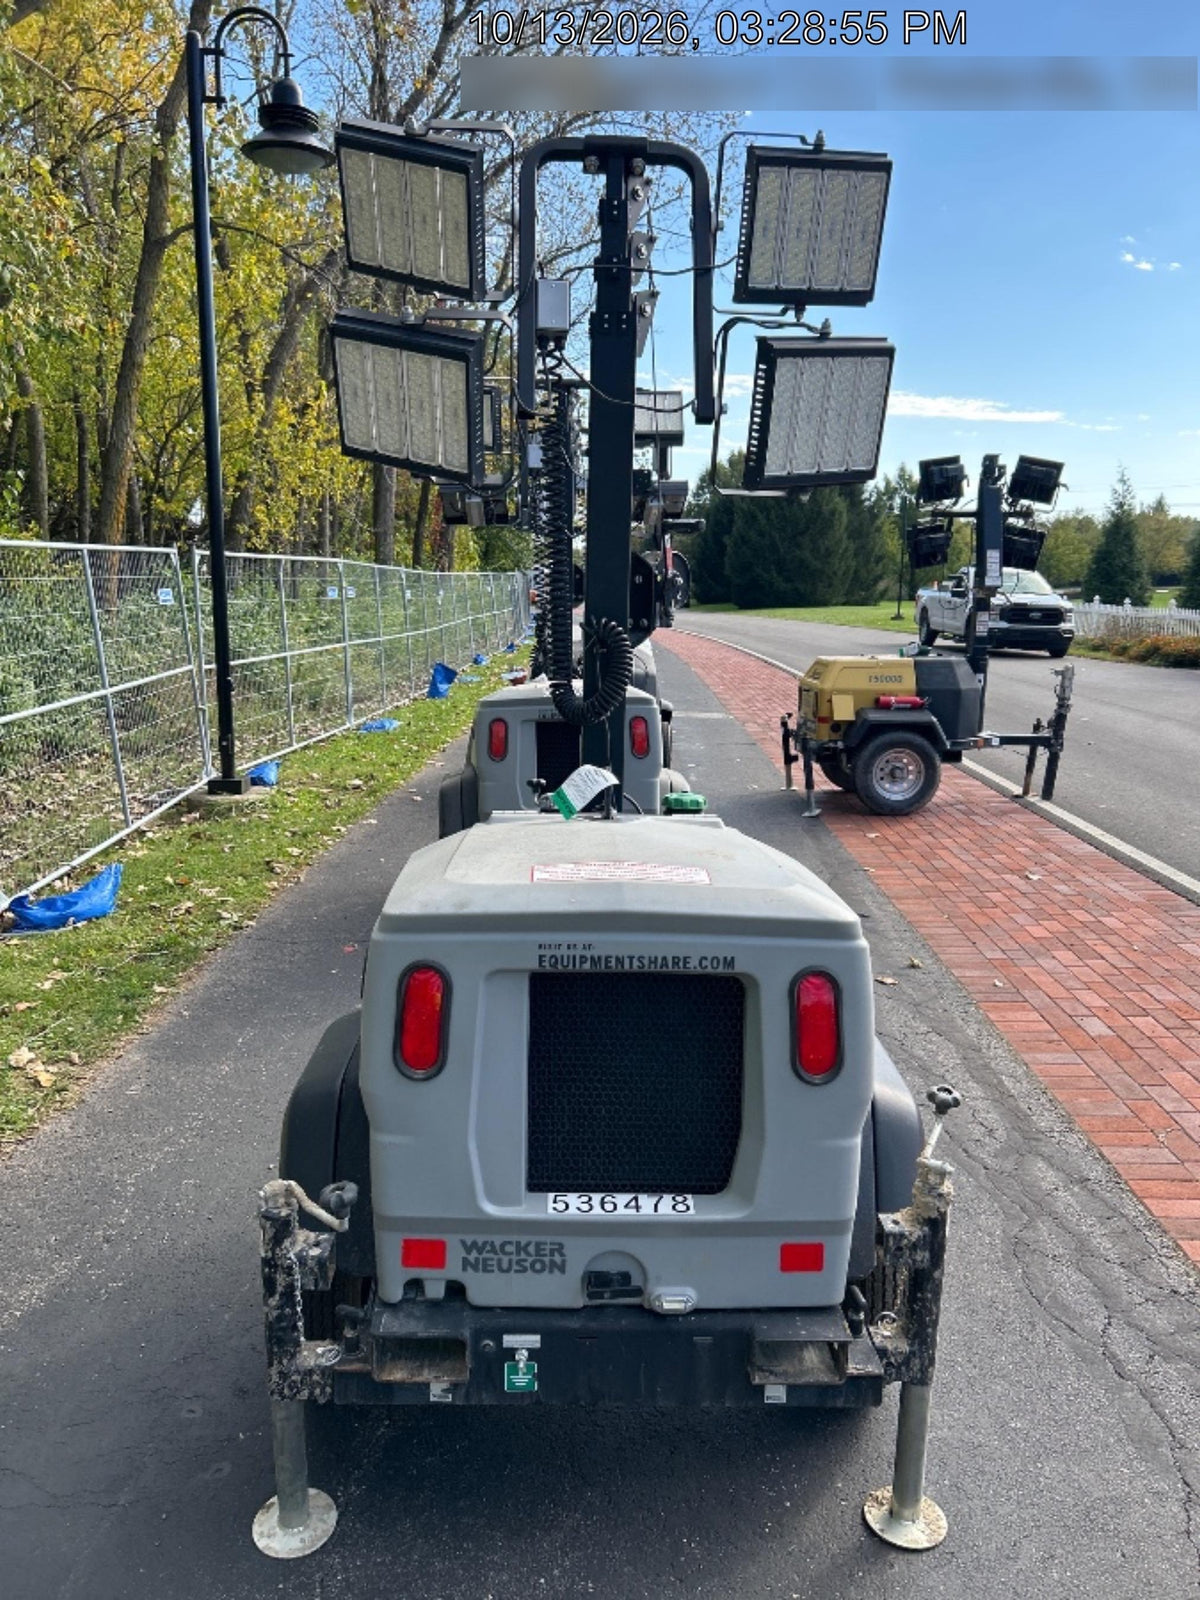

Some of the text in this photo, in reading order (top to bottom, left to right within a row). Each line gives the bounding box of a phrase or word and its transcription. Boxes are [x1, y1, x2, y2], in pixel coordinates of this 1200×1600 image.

[538, 954, 735, 971] EQUIPMENTSHARE.COM
[552, 1194, 691, 1213] 536478
[459, 1239, 566, 1257] WACKER
[461, 1257, 566, 1275] NEUSON
